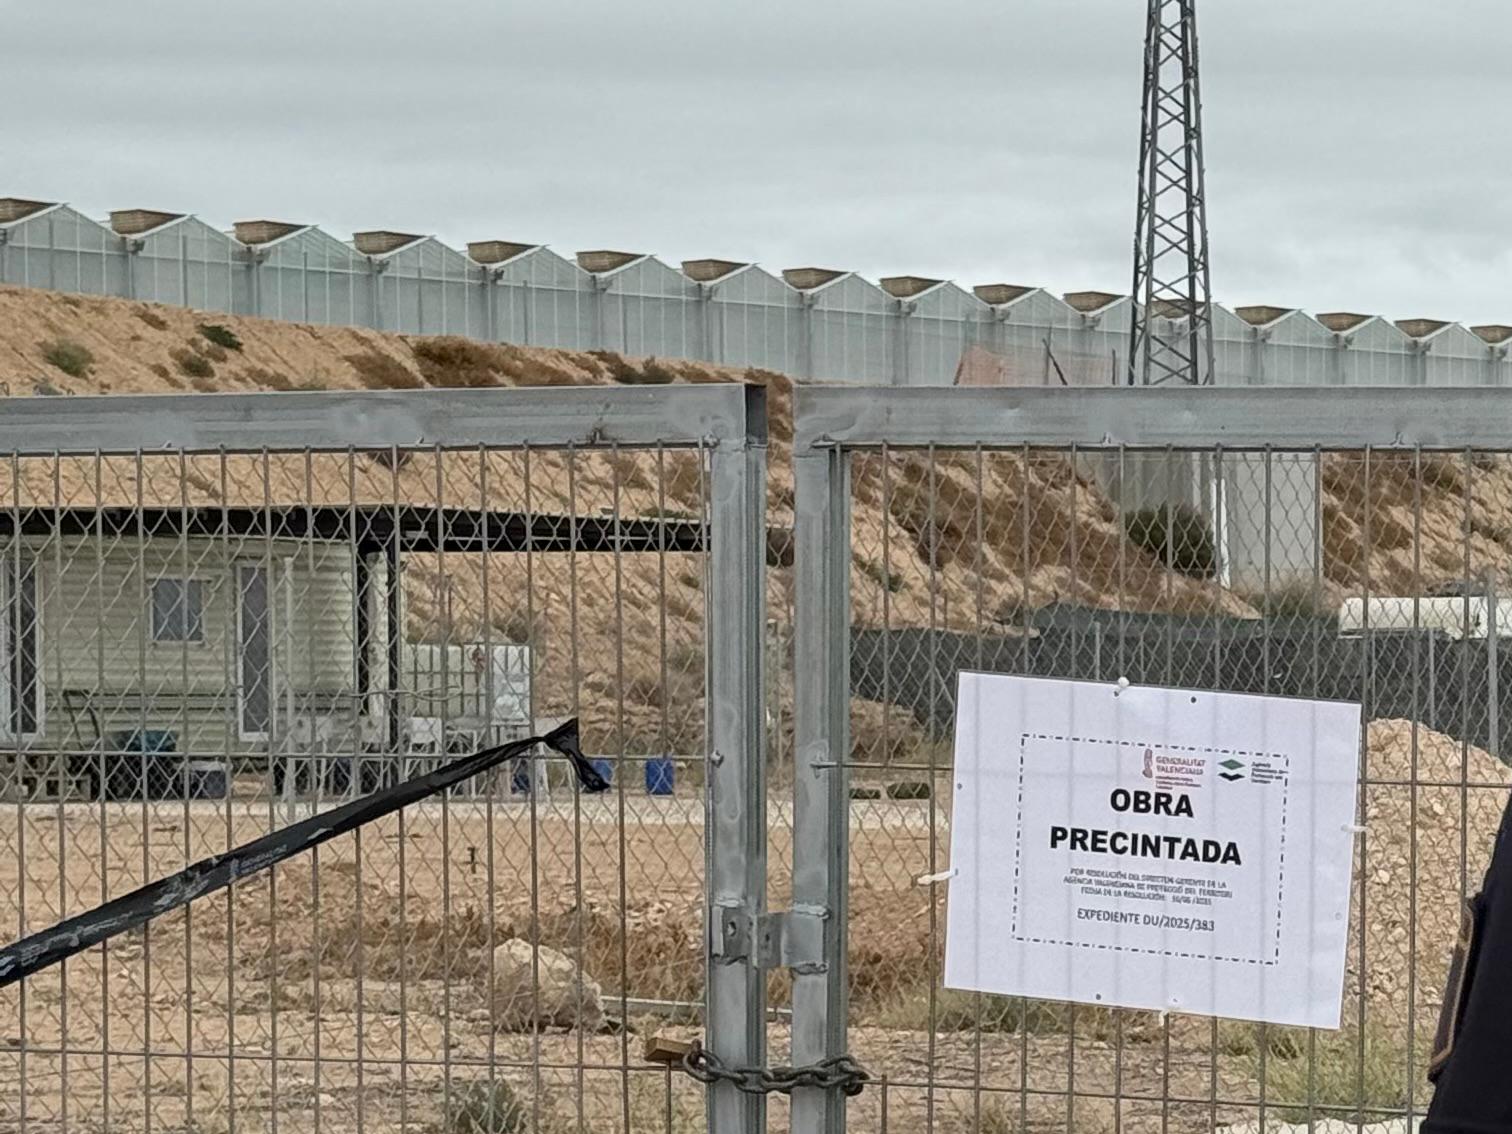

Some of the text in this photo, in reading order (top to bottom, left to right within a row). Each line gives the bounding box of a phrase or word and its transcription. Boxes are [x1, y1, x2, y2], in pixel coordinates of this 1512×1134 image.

[1110, 788, 1194, 818] OBRA
[1049, 826, 1242, 866] PRECINTADA
[1077, 908, 1141, 924] EXPEDIENTE
